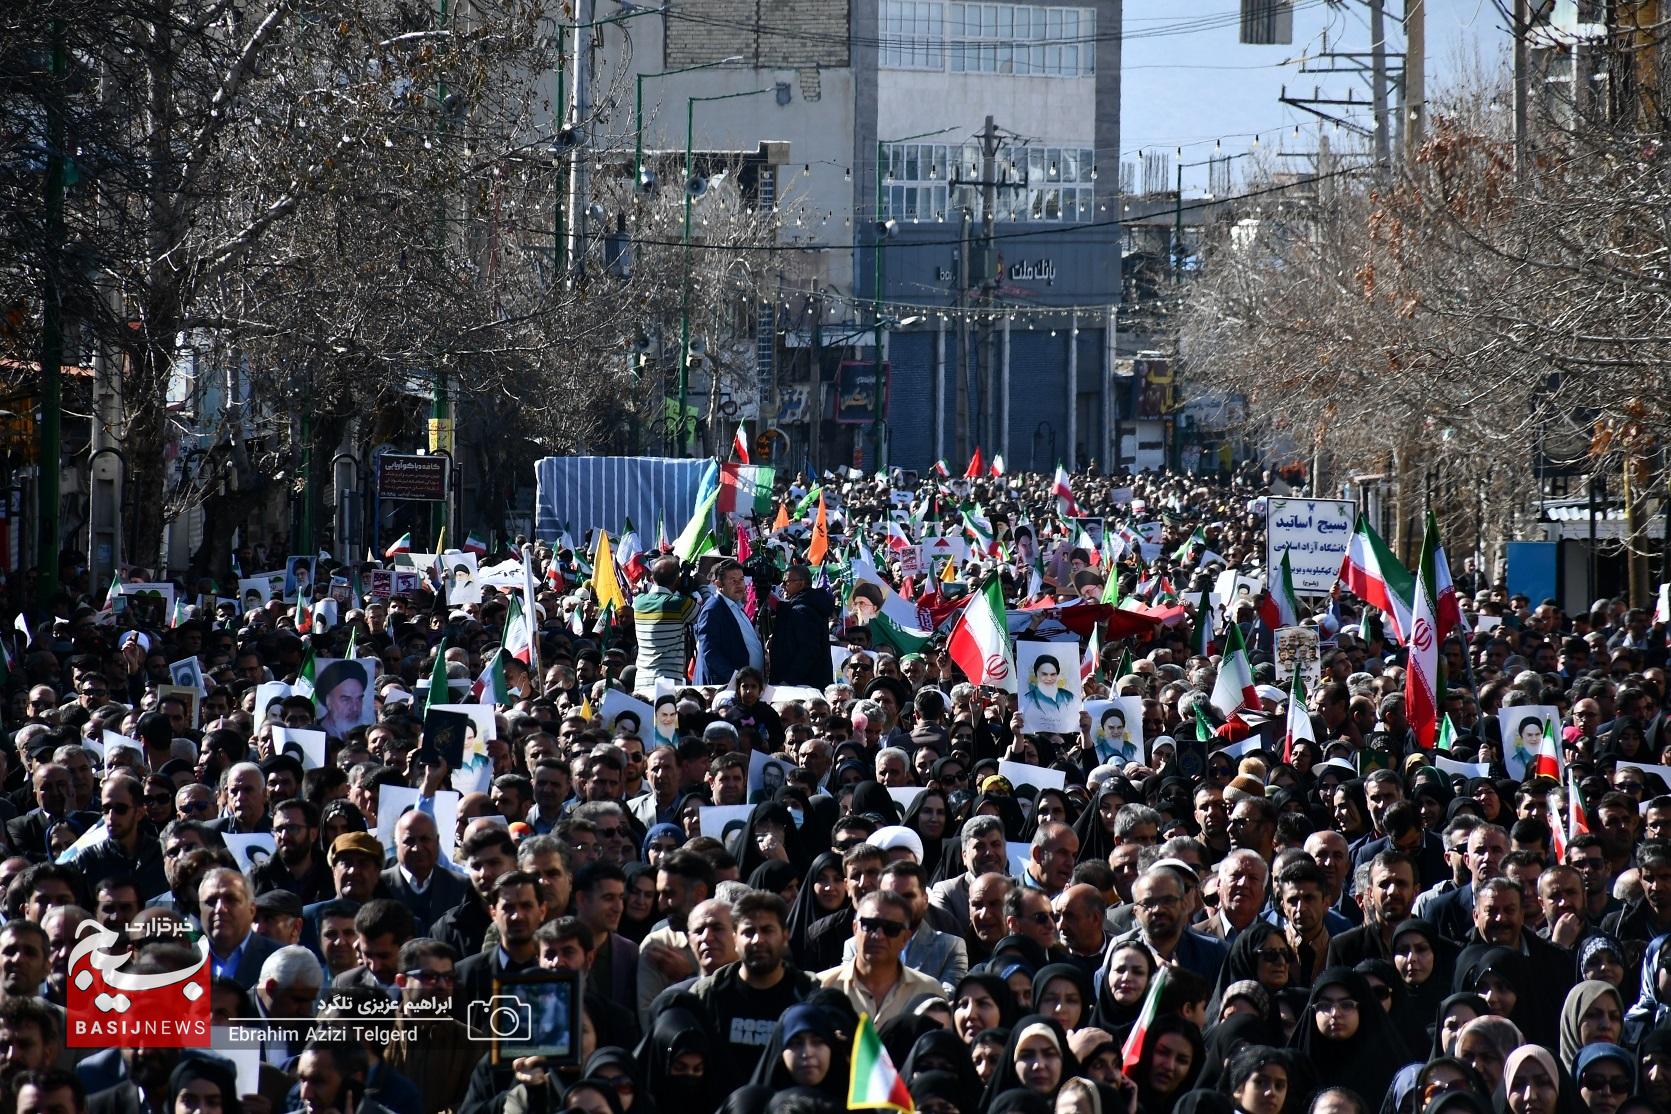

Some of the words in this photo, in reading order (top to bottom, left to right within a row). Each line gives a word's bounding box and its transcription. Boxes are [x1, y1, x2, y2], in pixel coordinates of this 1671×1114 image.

[1011, 259, 1033, 280] ملت
[1275, 514, 1313, 531] اساتید
[1317, 519, 1348, 534] بسیج
[1273, 540, 1301, 552] اسلامی
[1301, 541, 1318, 554] آزاد
[1319, 543, 1347, 553] دانشگاه
